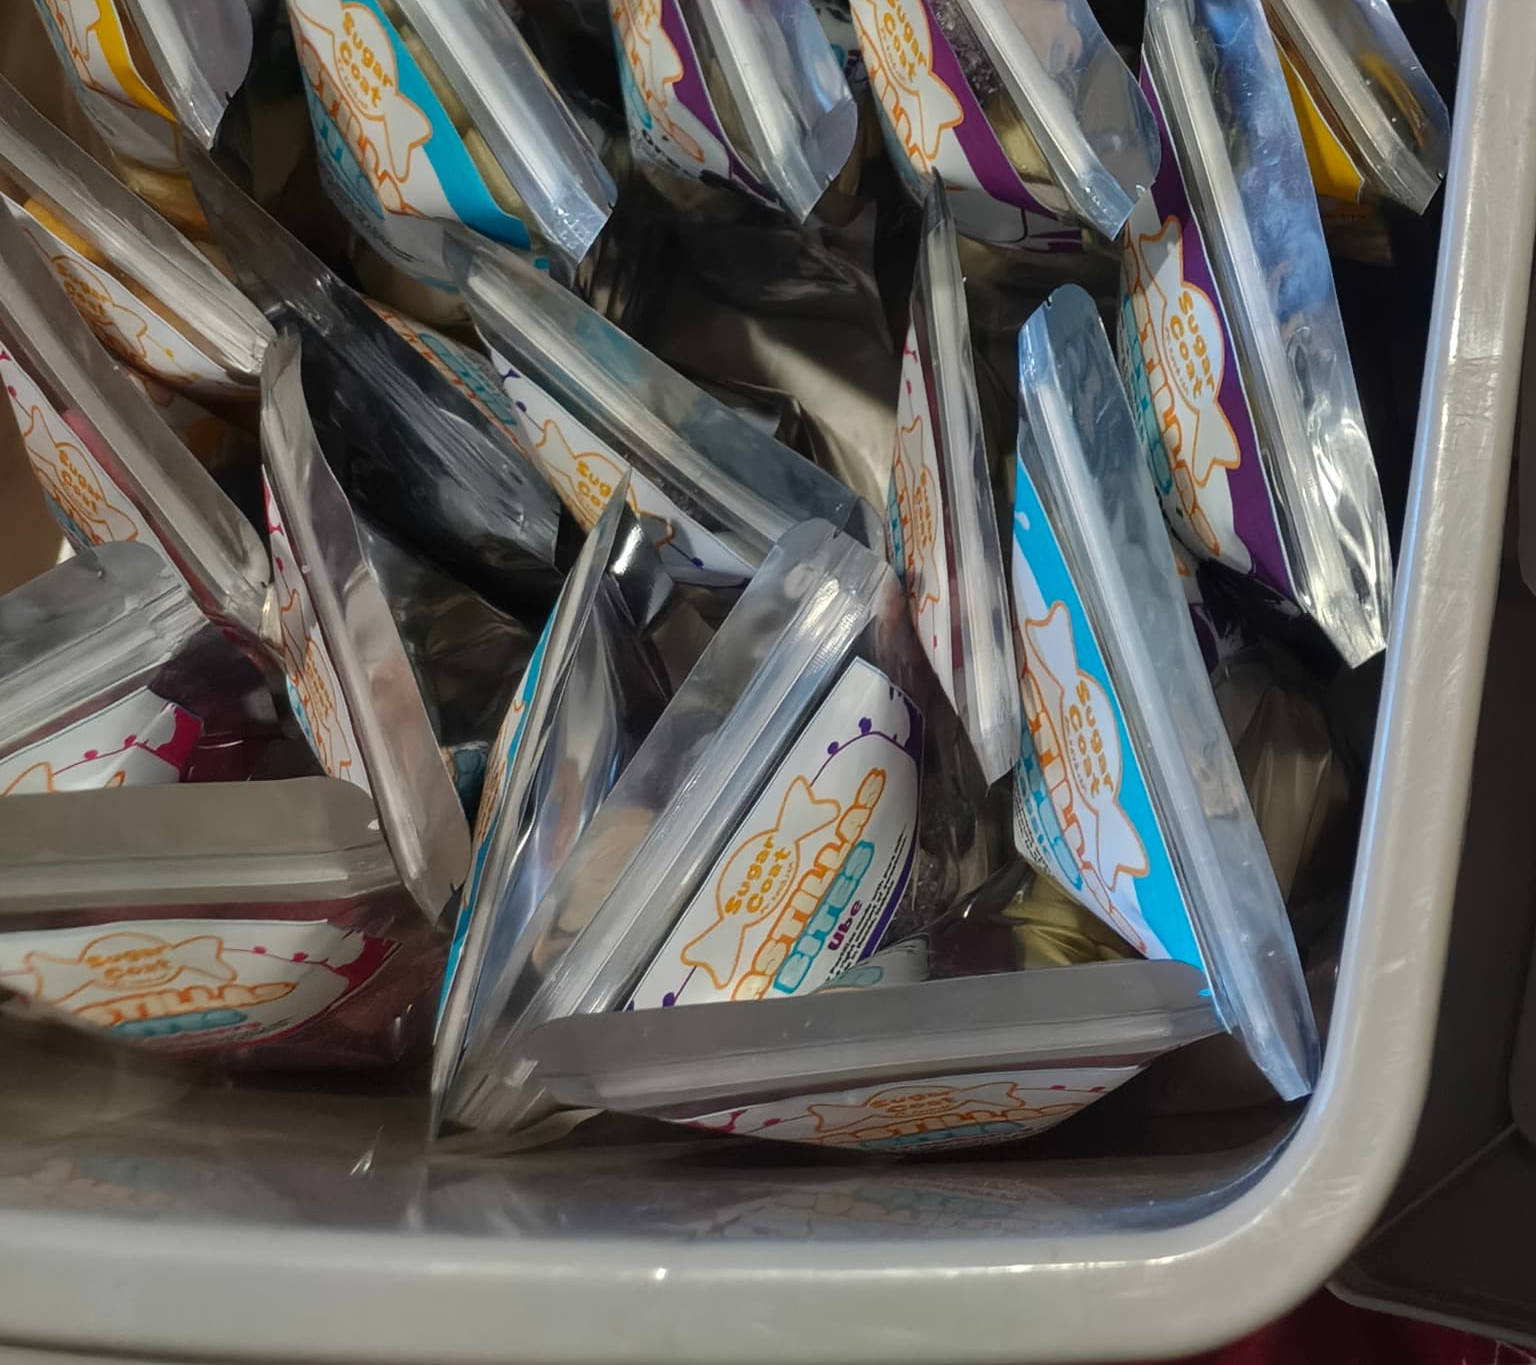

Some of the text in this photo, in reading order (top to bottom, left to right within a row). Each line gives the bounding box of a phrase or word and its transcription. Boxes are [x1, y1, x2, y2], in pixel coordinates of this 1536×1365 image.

[340, 41, 381, 107] Coat
[342, 11, 393, 87] Sugar
[883, 12, 915, 83] Coat
[1169, 315, 1201, 400] Coat
[1178, 290, 1214, 391] Sugar
[576, 461, 611, 497] Sug
[1069, 704, 1099, 799] Coat
[1076, 679, 1114, 793] Sugar
[725, 835, 775, 915] Sugar
[746, 847, 790, 914] Coat
[773, 840, 875, 994] BITES
[827, 900, 863, 950] Ube
